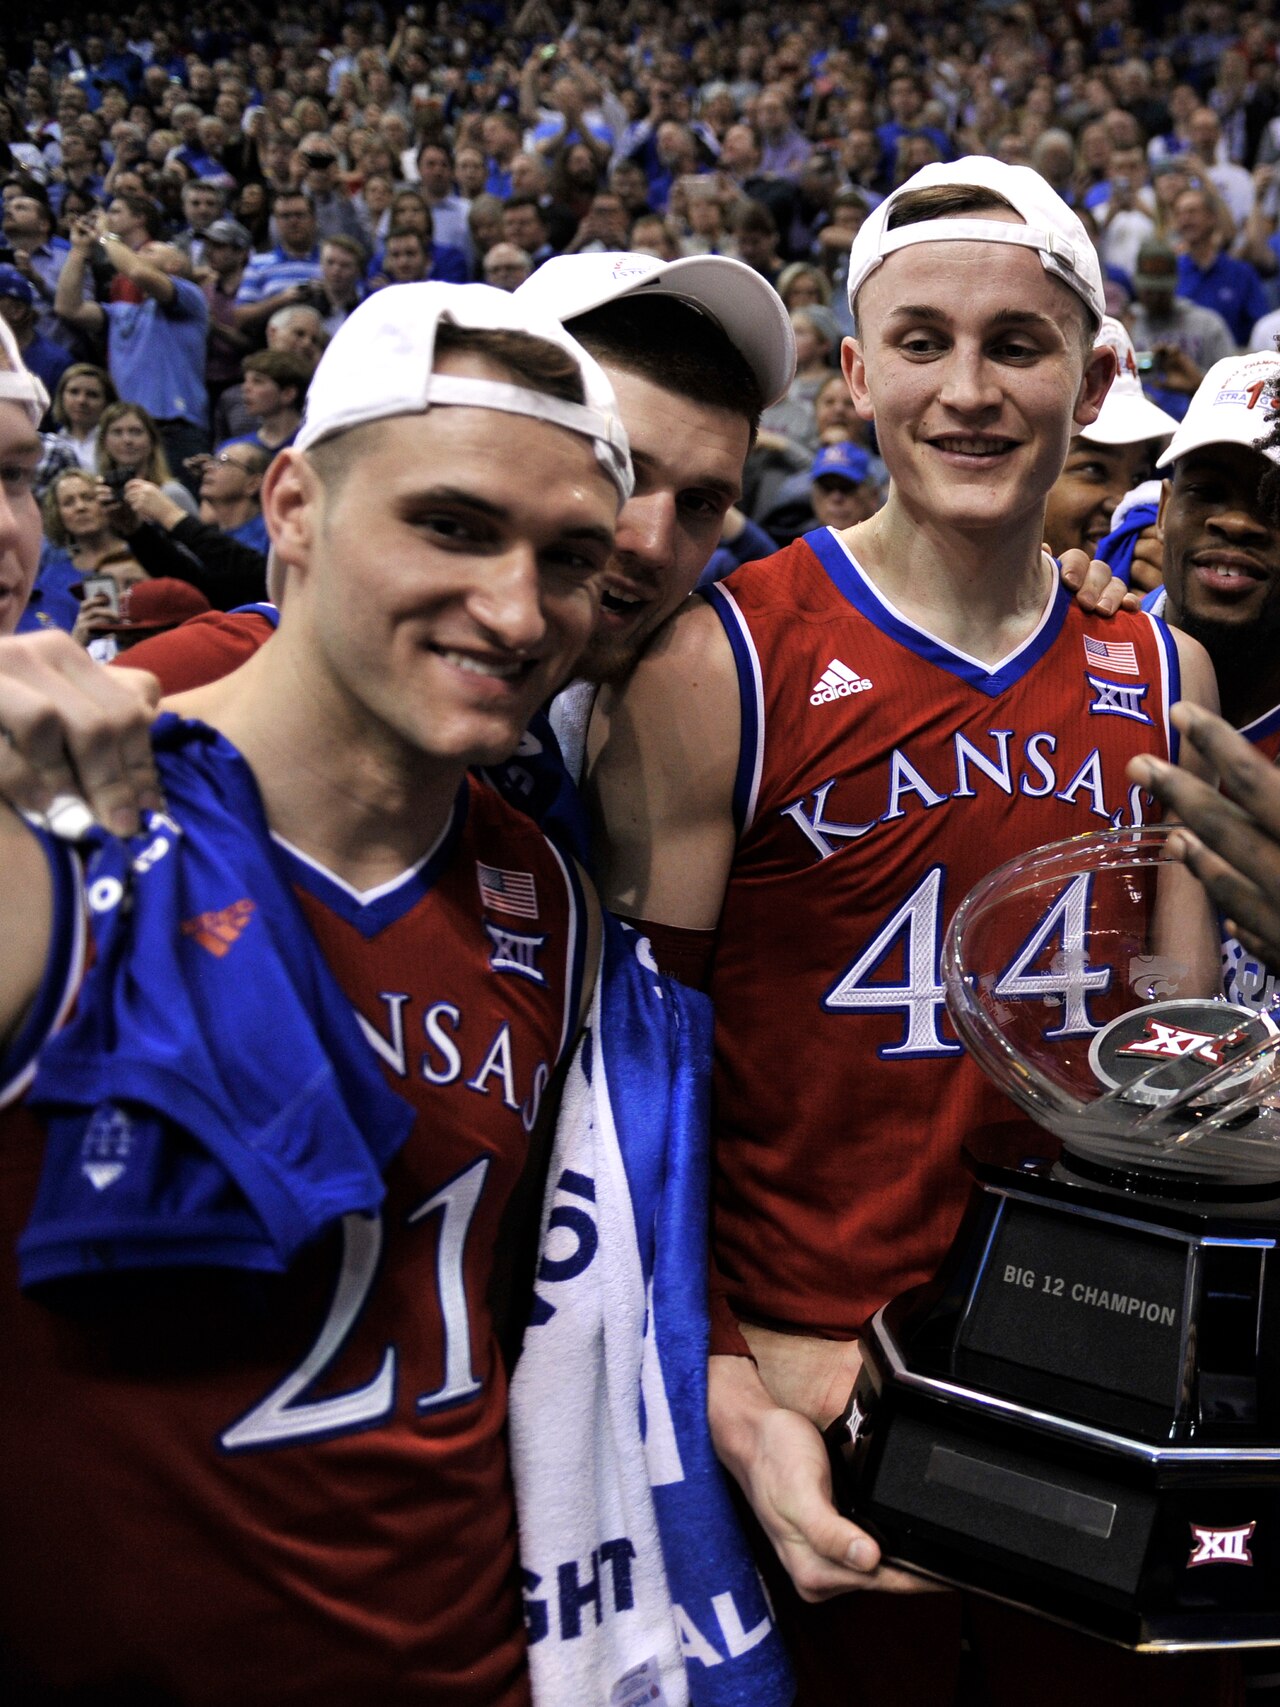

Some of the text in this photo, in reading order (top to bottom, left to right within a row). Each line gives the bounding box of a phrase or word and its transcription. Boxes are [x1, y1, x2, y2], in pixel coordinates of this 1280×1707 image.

[810, 679, 873, 706] adidas
[780, 729, 1155, 860] KANSAS
[825, 866, 1110, 1053] 44
[351, 992, 549, 1132] NSAS
[221, 1158, 490, 1448] 21
[1003, 1265, 1176, 1326] BIG 12 CHAMPION
[1192, 1527, 1251, 1562] XII
